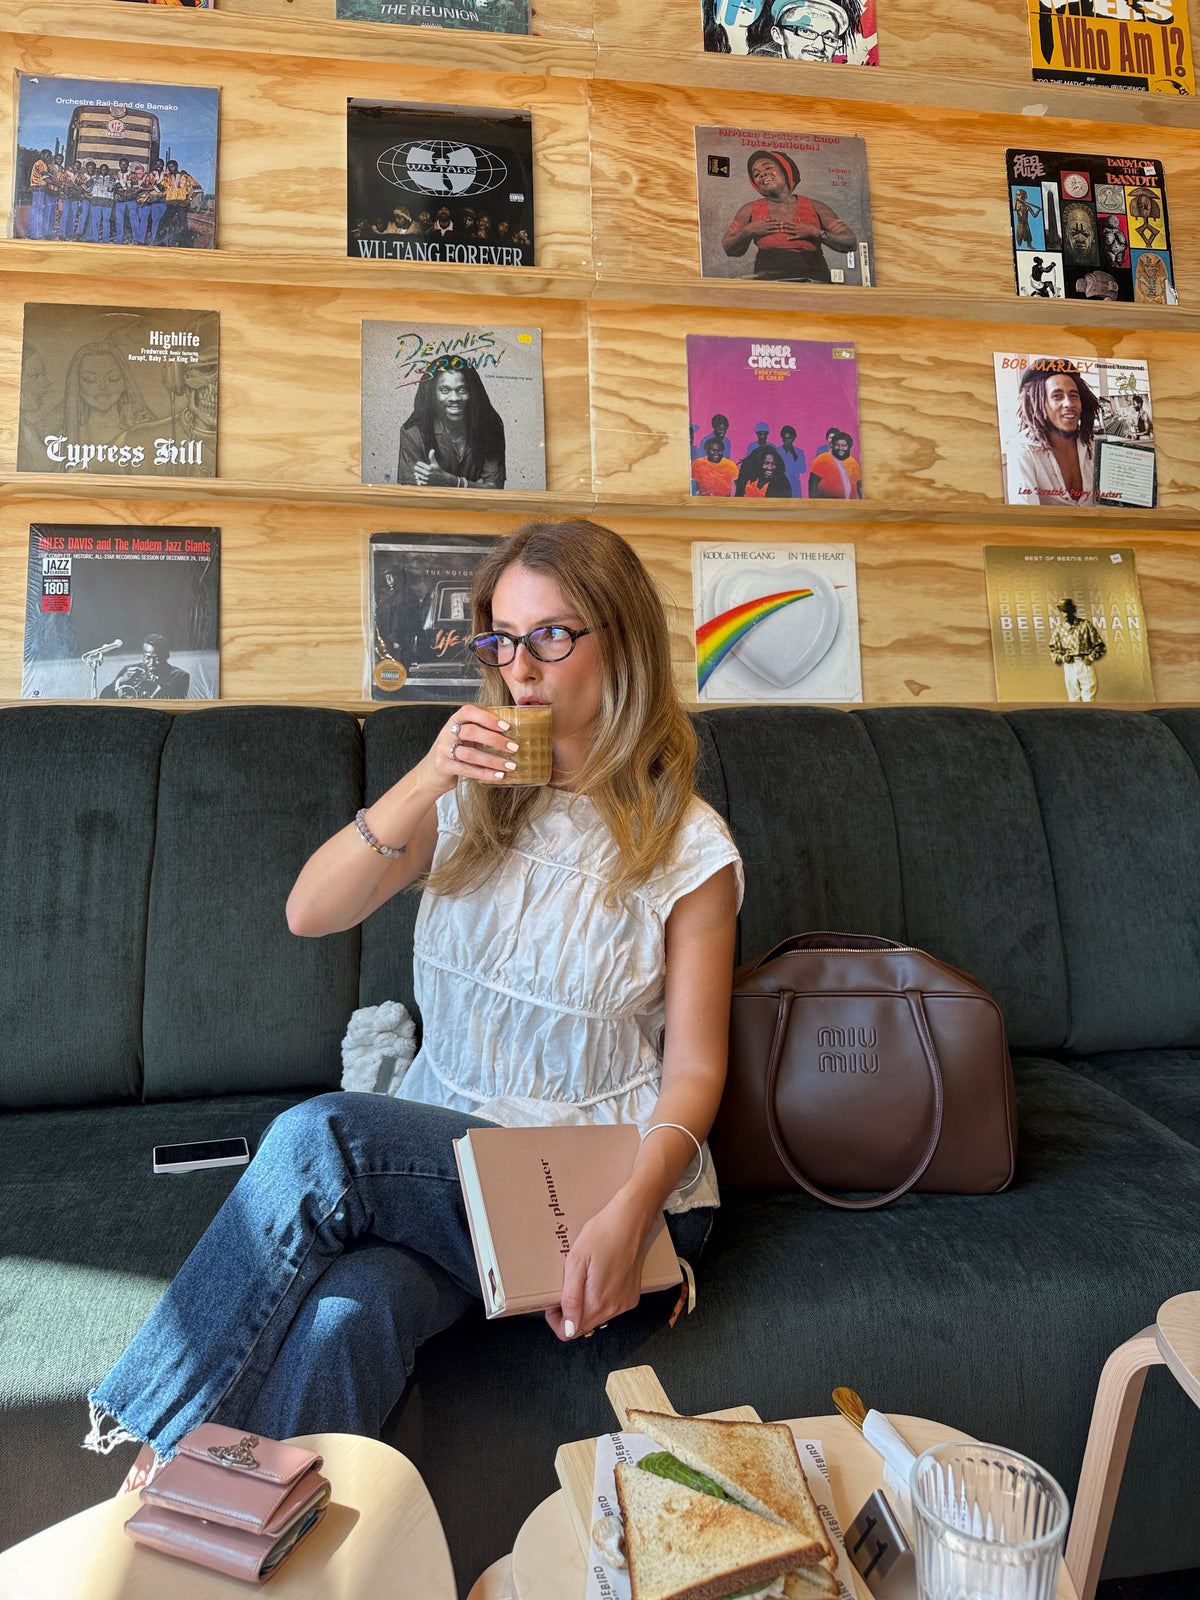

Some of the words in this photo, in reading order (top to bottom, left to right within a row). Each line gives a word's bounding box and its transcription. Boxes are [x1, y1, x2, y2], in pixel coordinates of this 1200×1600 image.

[380, 4, 407, 15] THE
[410, 4, 480, 22] REUNION
[1057, 16, 1111, 71] Who
[1119, 22, 1155, 75] Am
[1160, 25, 1187, 78] I?
[56, 97, 94, 106] Orchestre
[96, 99, 133, 109] Rail-Band
[147, 103, 178, 111] Bamako
[406, 163, 477, 174] WU-TANG
[1106, 157, 1155, 168] BABYLON
[1105, 173, 1158, 187] BANDIT
[357, 239, 441, 261] WU-TANG
[444, 244, 523, 266] FOREVER
[150, 331, 200, 349] Highlife
[395, 332, 495, 360] DENNIS
[141, 347, 169, 355] Fredwreck
[751, 344, 791, 357] INNER
[177, 356, 188, 364] King
[399, 349, 505, 380] BROWN
[748, 356, 797, 369] CIRCLE
[1001, 357, 1028, 370] BOB
[1031, 359, 1094, 374] MARLEY
[44, 435, 145, 470] Cypress
[153, 438, 203, 466] Hill
[1018, 487, 1032, 495] Lee
[1070, 489, 1091, 501] Perry
[1092, 489, 1123, 499] Masters
[38, 537, 65, 550] MILES
[68, 537, 93, 550] DAVIS
[96, 538, 111, 550] and
[114, 538, 129, 551] The
[132, 538, 162, 551] Modern
[164, 539, 182, 552] Jazz
[185, 539, 211, 552] Giants
[703, 551, 724, 560] KOOL
[731, 552, 749, 560] THE
[749, 552, 776, 560] GANG
[788, 552, 798, 560] IN
[799, 552, 817, 560] THE
[818, 552, 845, 561] HEART
[44, 559, 69, 574] JAZZ
[43, 582, 63, 595] 180
[999, 603, 1087, 616] BEENE
[1092, 616, 1140, 629] MAN
[817, 1026, 877, 1048] MIU
[818, 1051, 879, 1074] MIU
[541, 1158, 565, 1217] planner
